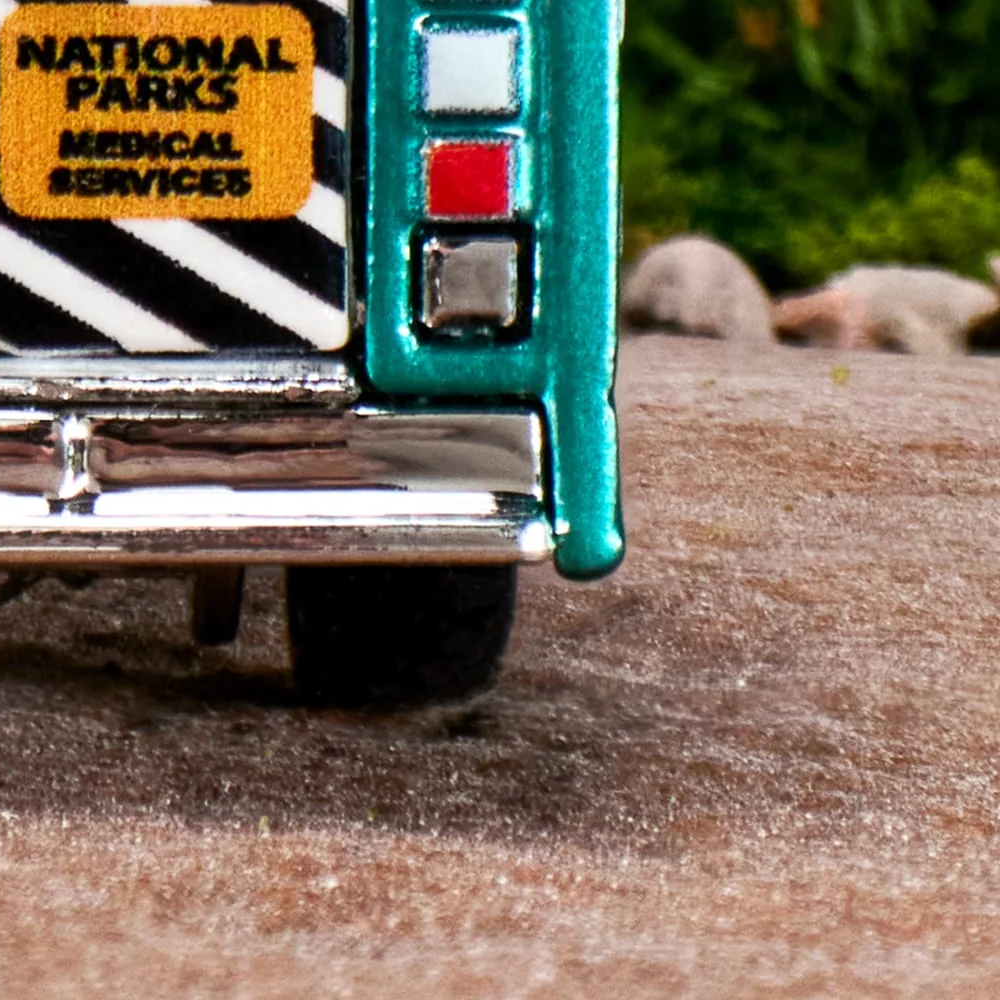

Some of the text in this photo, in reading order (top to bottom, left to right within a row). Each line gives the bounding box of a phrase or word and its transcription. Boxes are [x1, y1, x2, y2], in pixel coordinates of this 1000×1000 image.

[16, 35, 297, 72] NATIONAL
[66, 75, 239, 111] PARKS
[59, 130, 243, 160] MEDICAL
[48, 168, 252, 196] SERVICES
